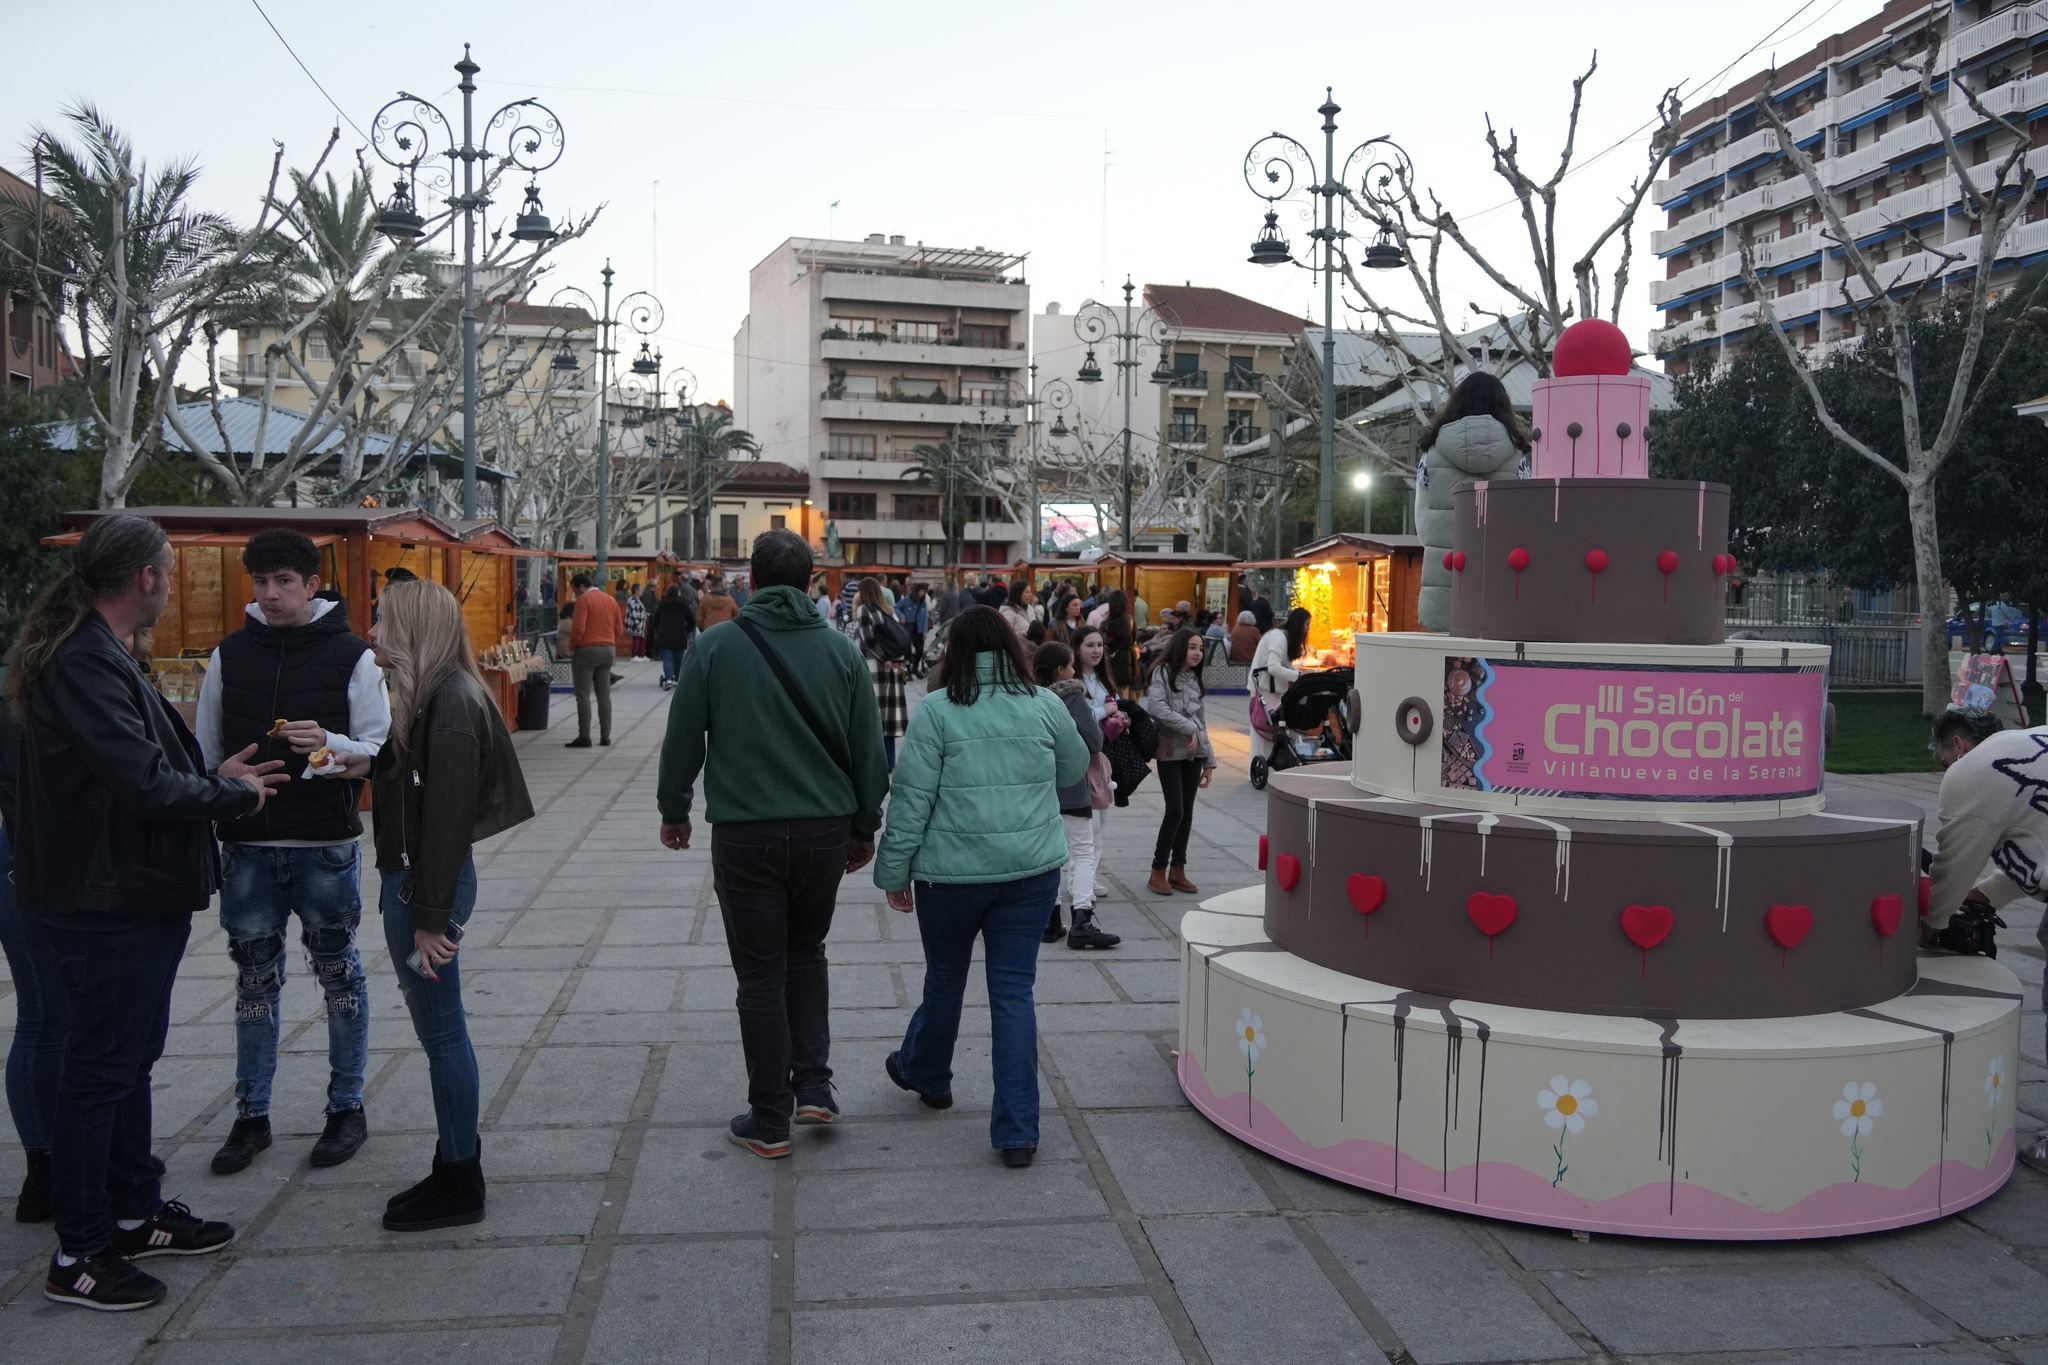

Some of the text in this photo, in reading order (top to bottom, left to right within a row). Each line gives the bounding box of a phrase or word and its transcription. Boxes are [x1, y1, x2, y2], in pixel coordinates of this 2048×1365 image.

[1598, 685, 1744, 715] III Salón del
[1544, 703, 1803, 758] Chocolate
[1543, 760, 1677, 780] Villanueva
[1688, 765, 1713, 780] de
[1723, 765, 1740, 780] la
[1749, 765, 1802, 780] Serena
